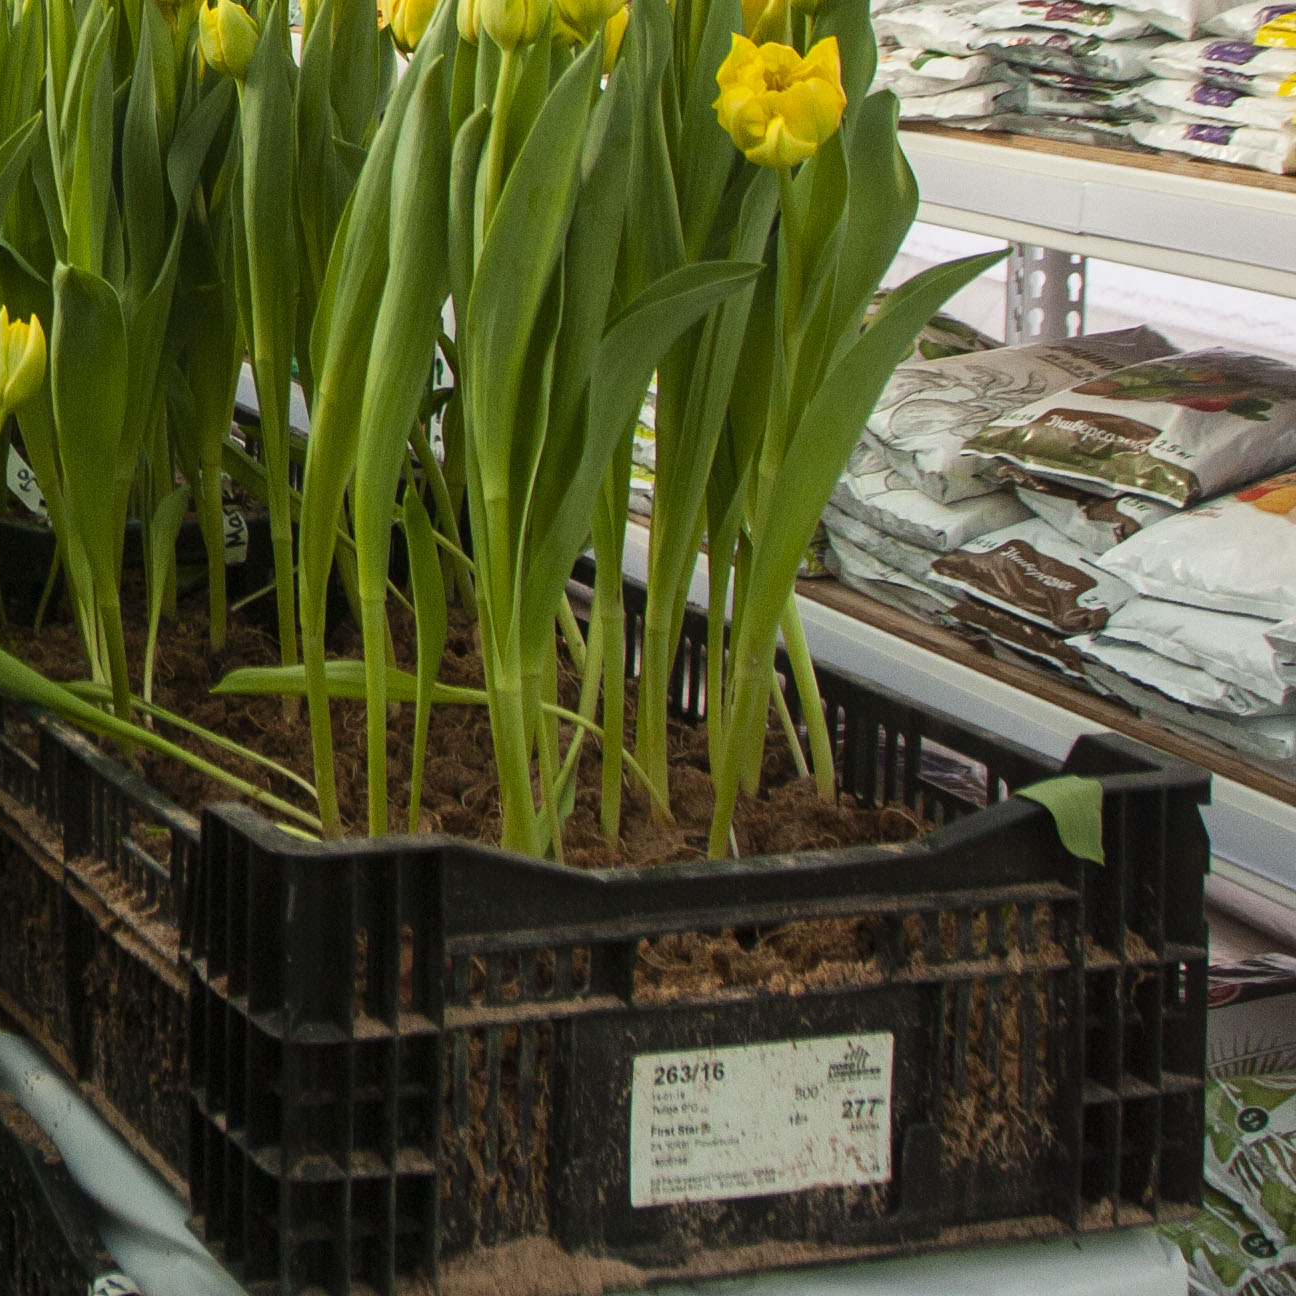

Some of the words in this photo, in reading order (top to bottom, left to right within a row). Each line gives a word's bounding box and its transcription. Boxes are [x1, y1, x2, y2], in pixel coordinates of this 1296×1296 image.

[654, 1062, 725, 1085] 263/16
[651, 1125, 675, 1137] First
[678, 1124, 698, 1137] Star
